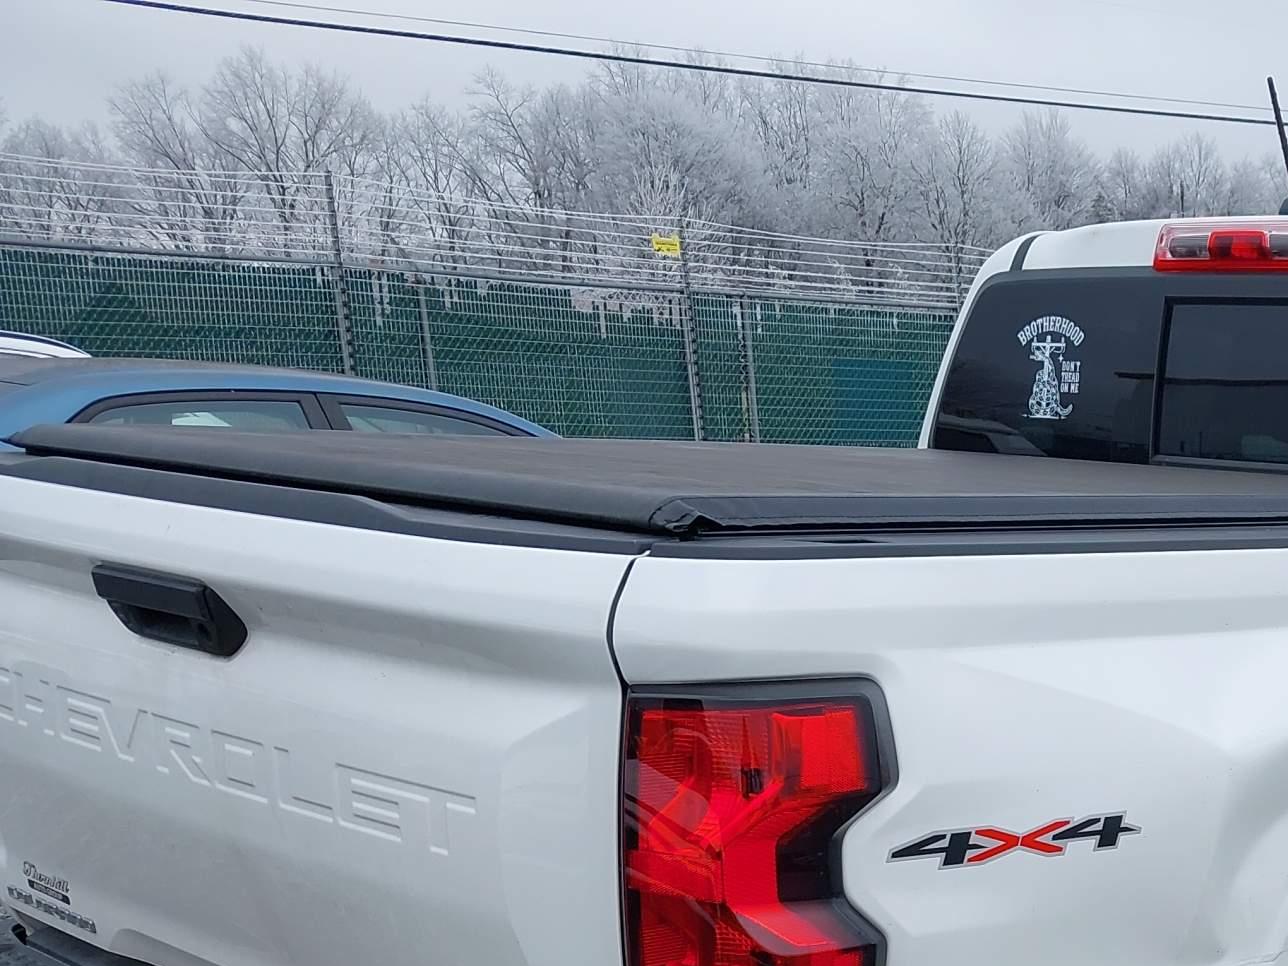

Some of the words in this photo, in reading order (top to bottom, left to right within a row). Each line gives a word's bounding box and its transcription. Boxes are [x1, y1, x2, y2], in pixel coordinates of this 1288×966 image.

[1017, 315, 1086, 347] BROTHERHOOD
[1060, 383, 1069, 393] ON
[1070, 383, 1079, 394] ME
